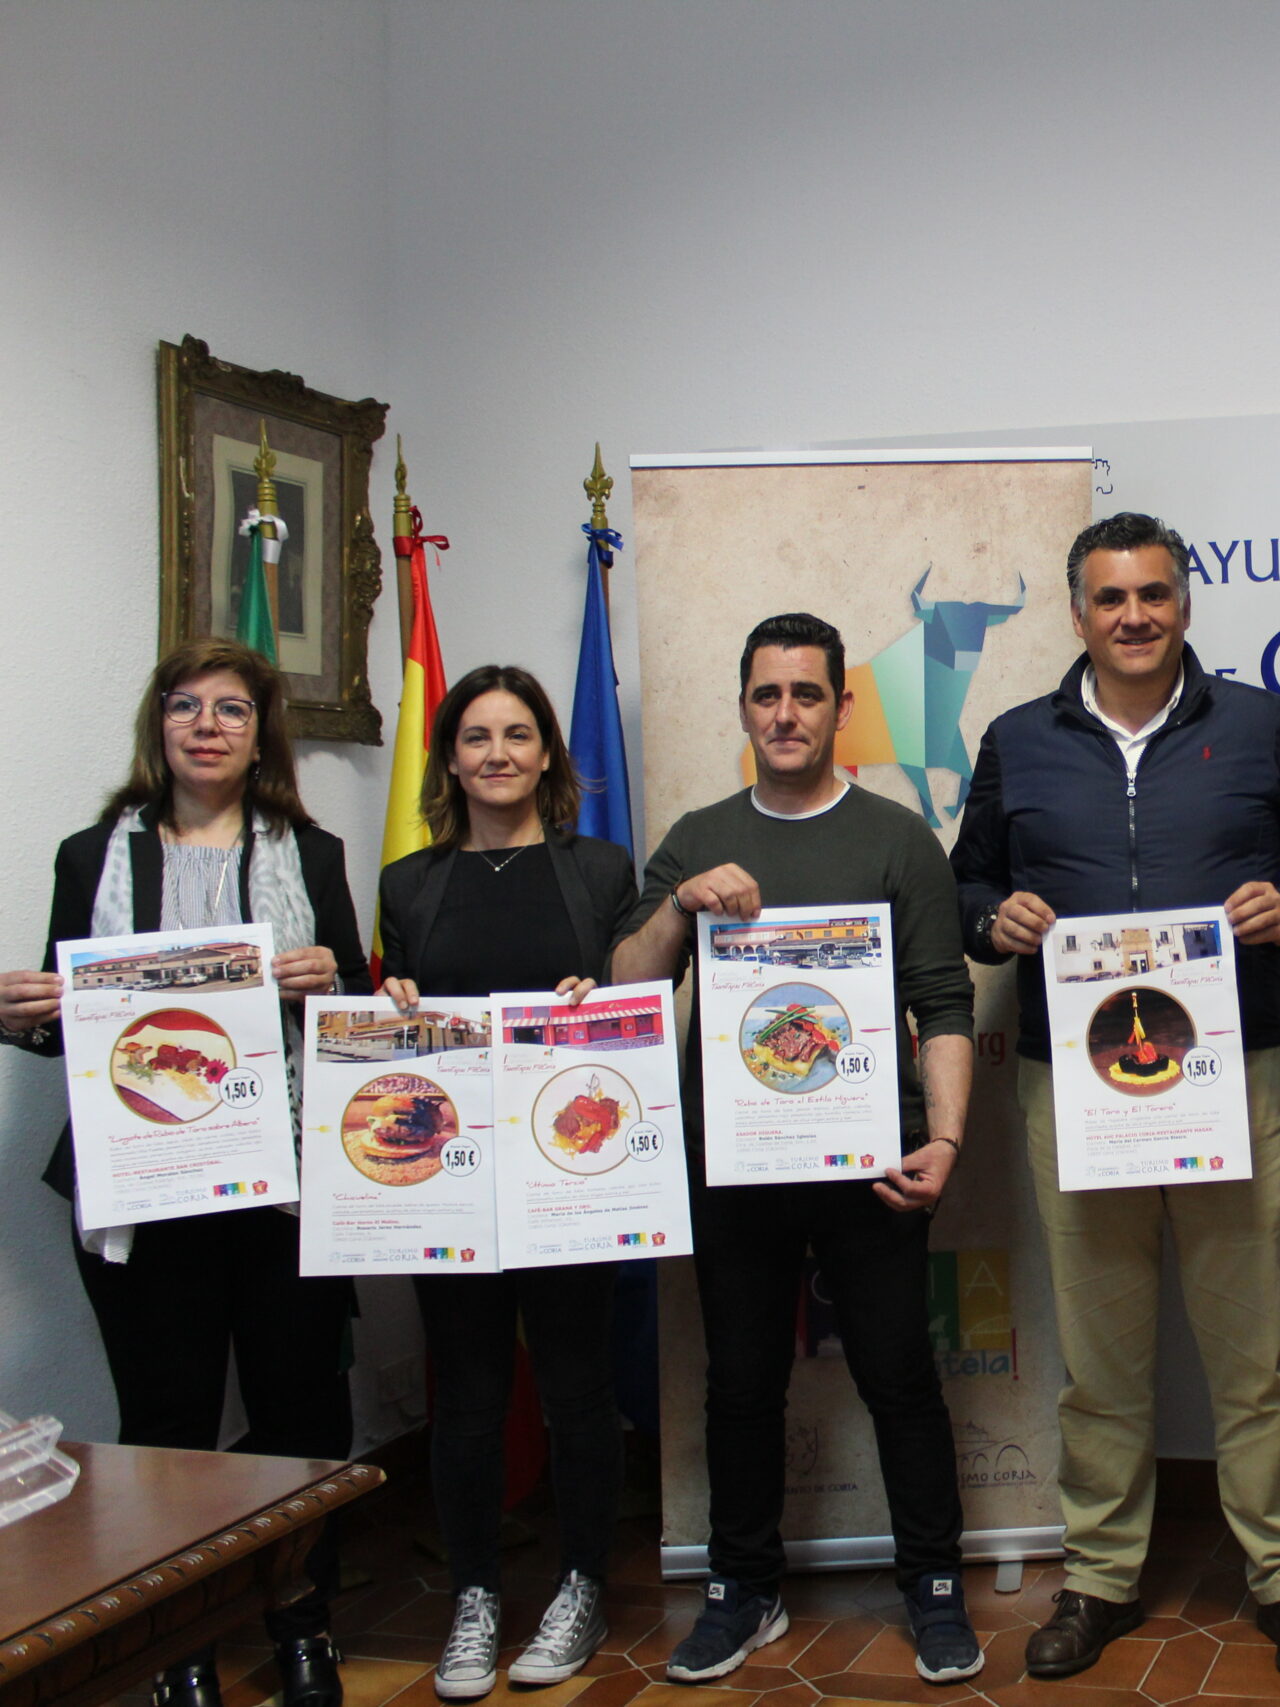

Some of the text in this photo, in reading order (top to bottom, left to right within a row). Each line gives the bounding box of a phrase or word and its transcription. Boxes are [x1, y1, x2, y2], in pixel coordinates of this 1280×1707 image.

[840, 1057, 870, 1076] 1,50 €
[1187, 1059, 1216, 1079] 1,50 €
[224, 1080, 257, 1102] 1,50 €
[1101, 1108, 1120, 1116] Toro
[630, 1134, 658, 1155] 1,50 €
[445, 1150, 475, 1169] 1,50 €
[993, 1469, 1037, 1482] CORIA
